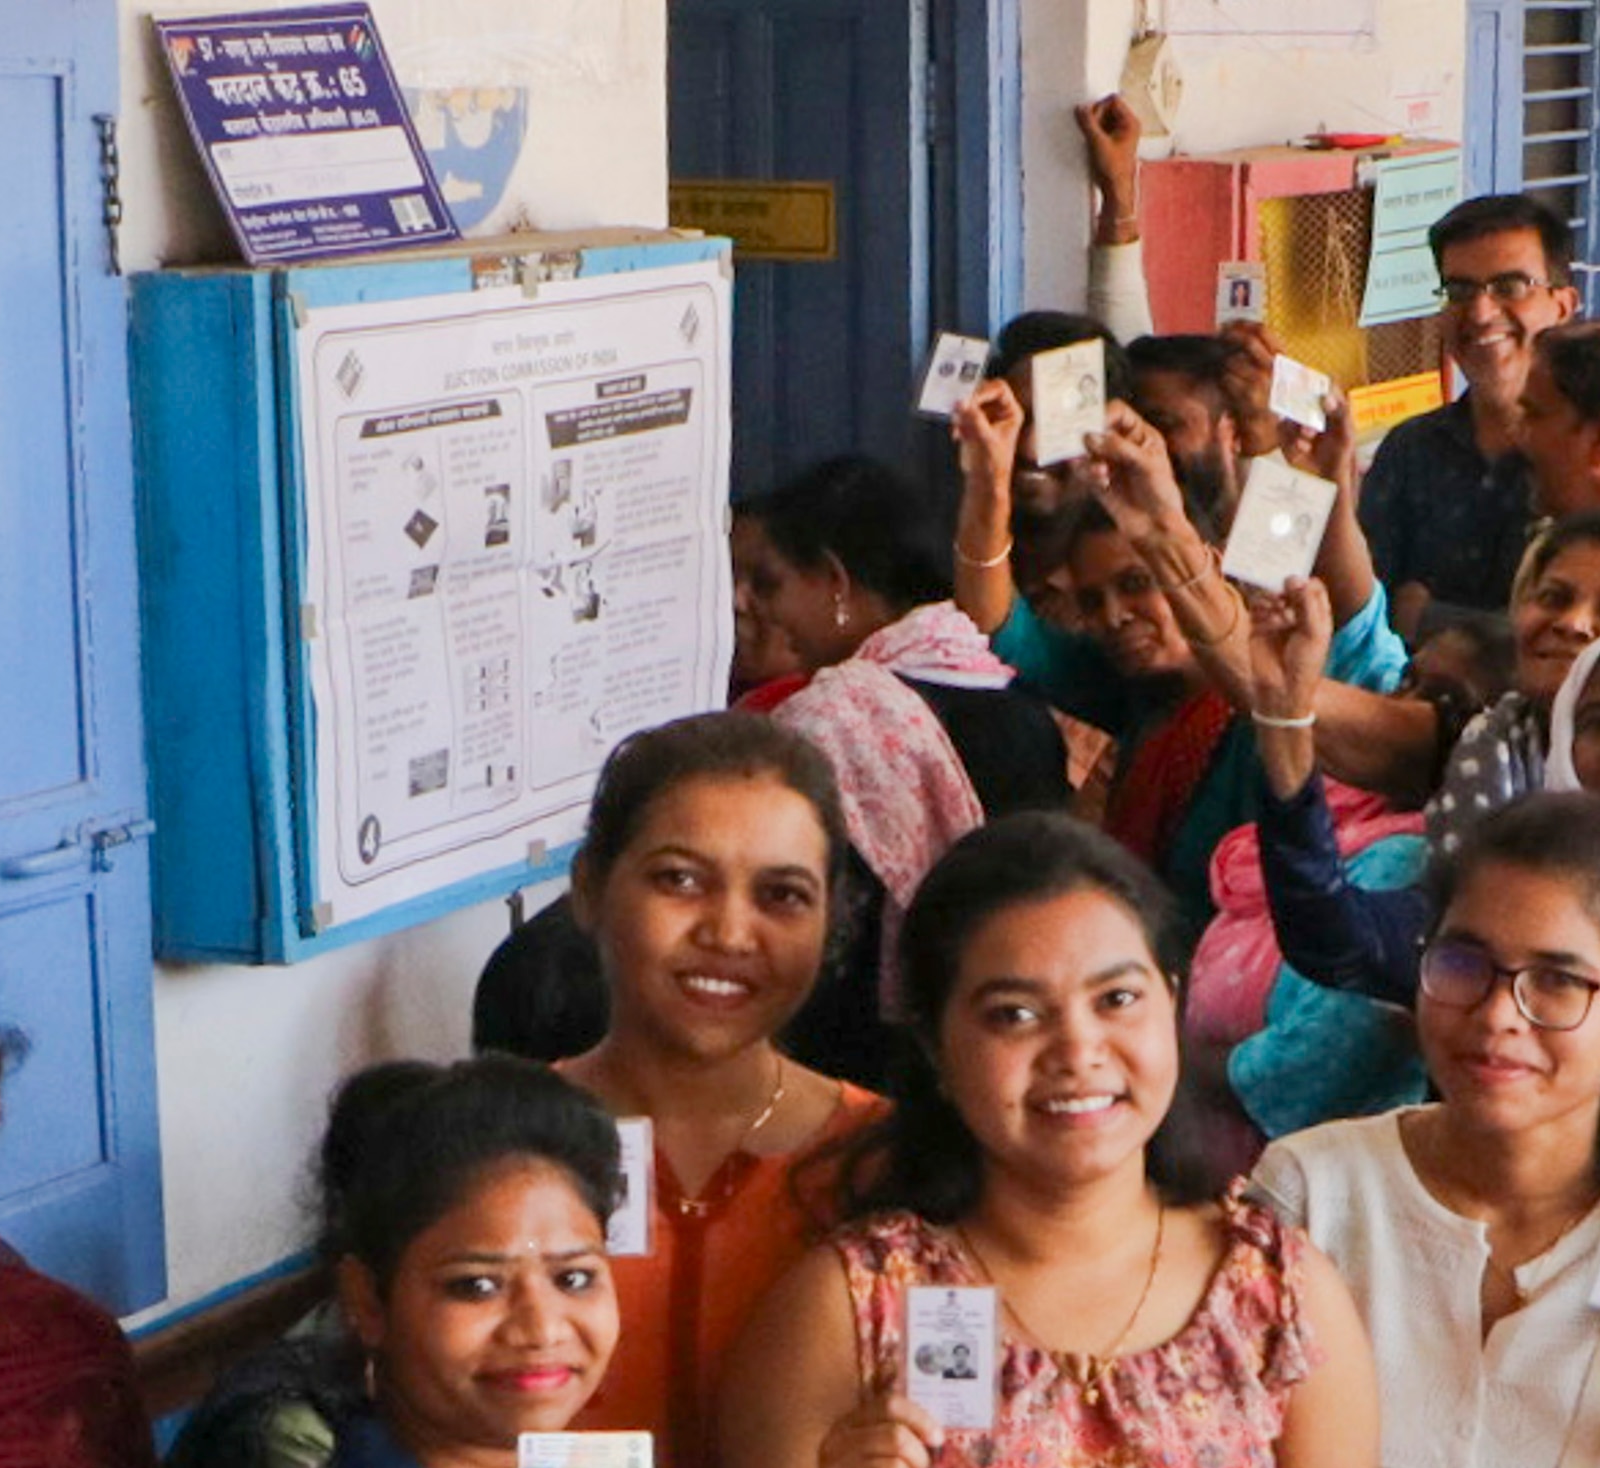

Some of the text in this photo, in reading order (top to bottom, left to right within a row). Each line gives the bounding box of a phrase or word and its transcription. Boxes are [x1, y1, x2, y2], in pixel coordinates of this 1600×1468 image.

[206, 73, 274, 107] मतदान
[337, 65, 368, 98] 65
[501, 356, 574, 381] COMMISSION
[575, 352, 588, 370] OF
